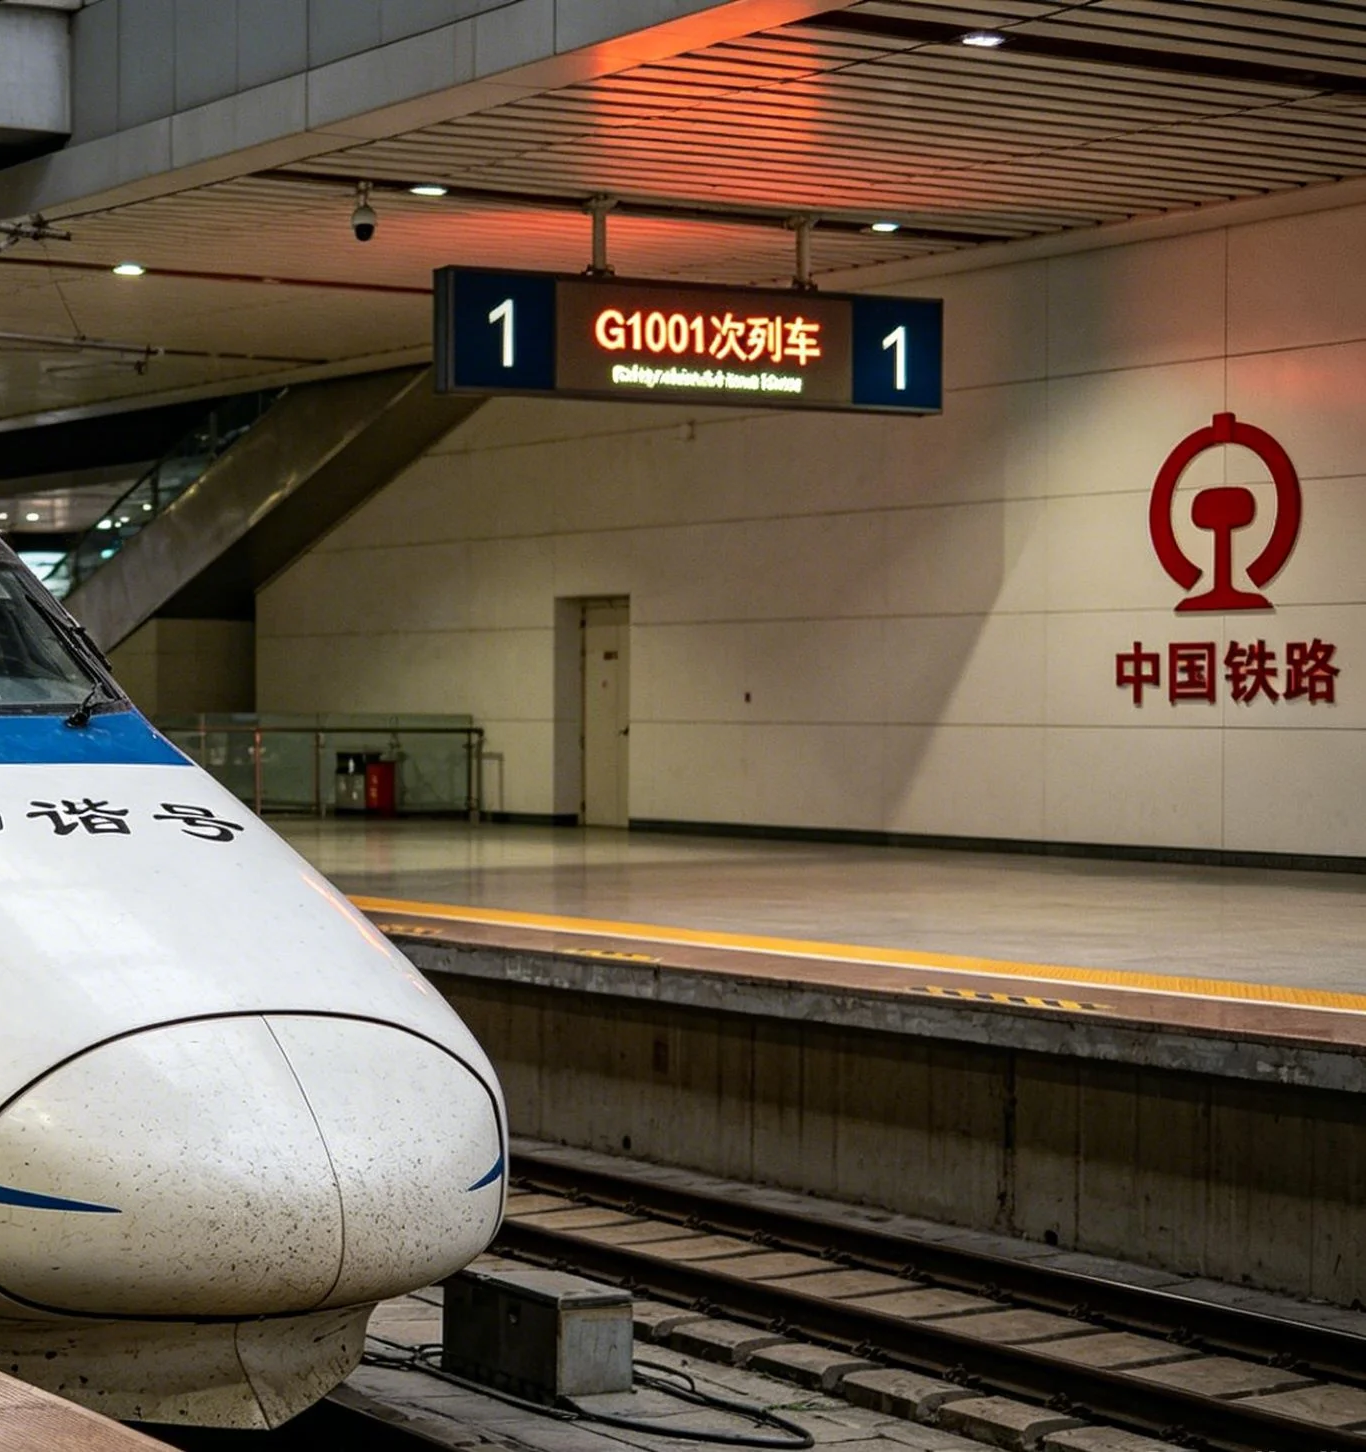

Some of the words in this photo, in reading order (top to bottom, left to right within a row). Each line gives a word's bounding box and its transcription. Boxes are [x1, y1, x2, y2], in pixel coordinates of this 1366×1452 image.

[488, 299, 515, 367] 1
[595, 309, 821, 366] G1001次列车
[882, 325, 906, 390] 1
[1116, 638, 1341, 705] 中国铁路
